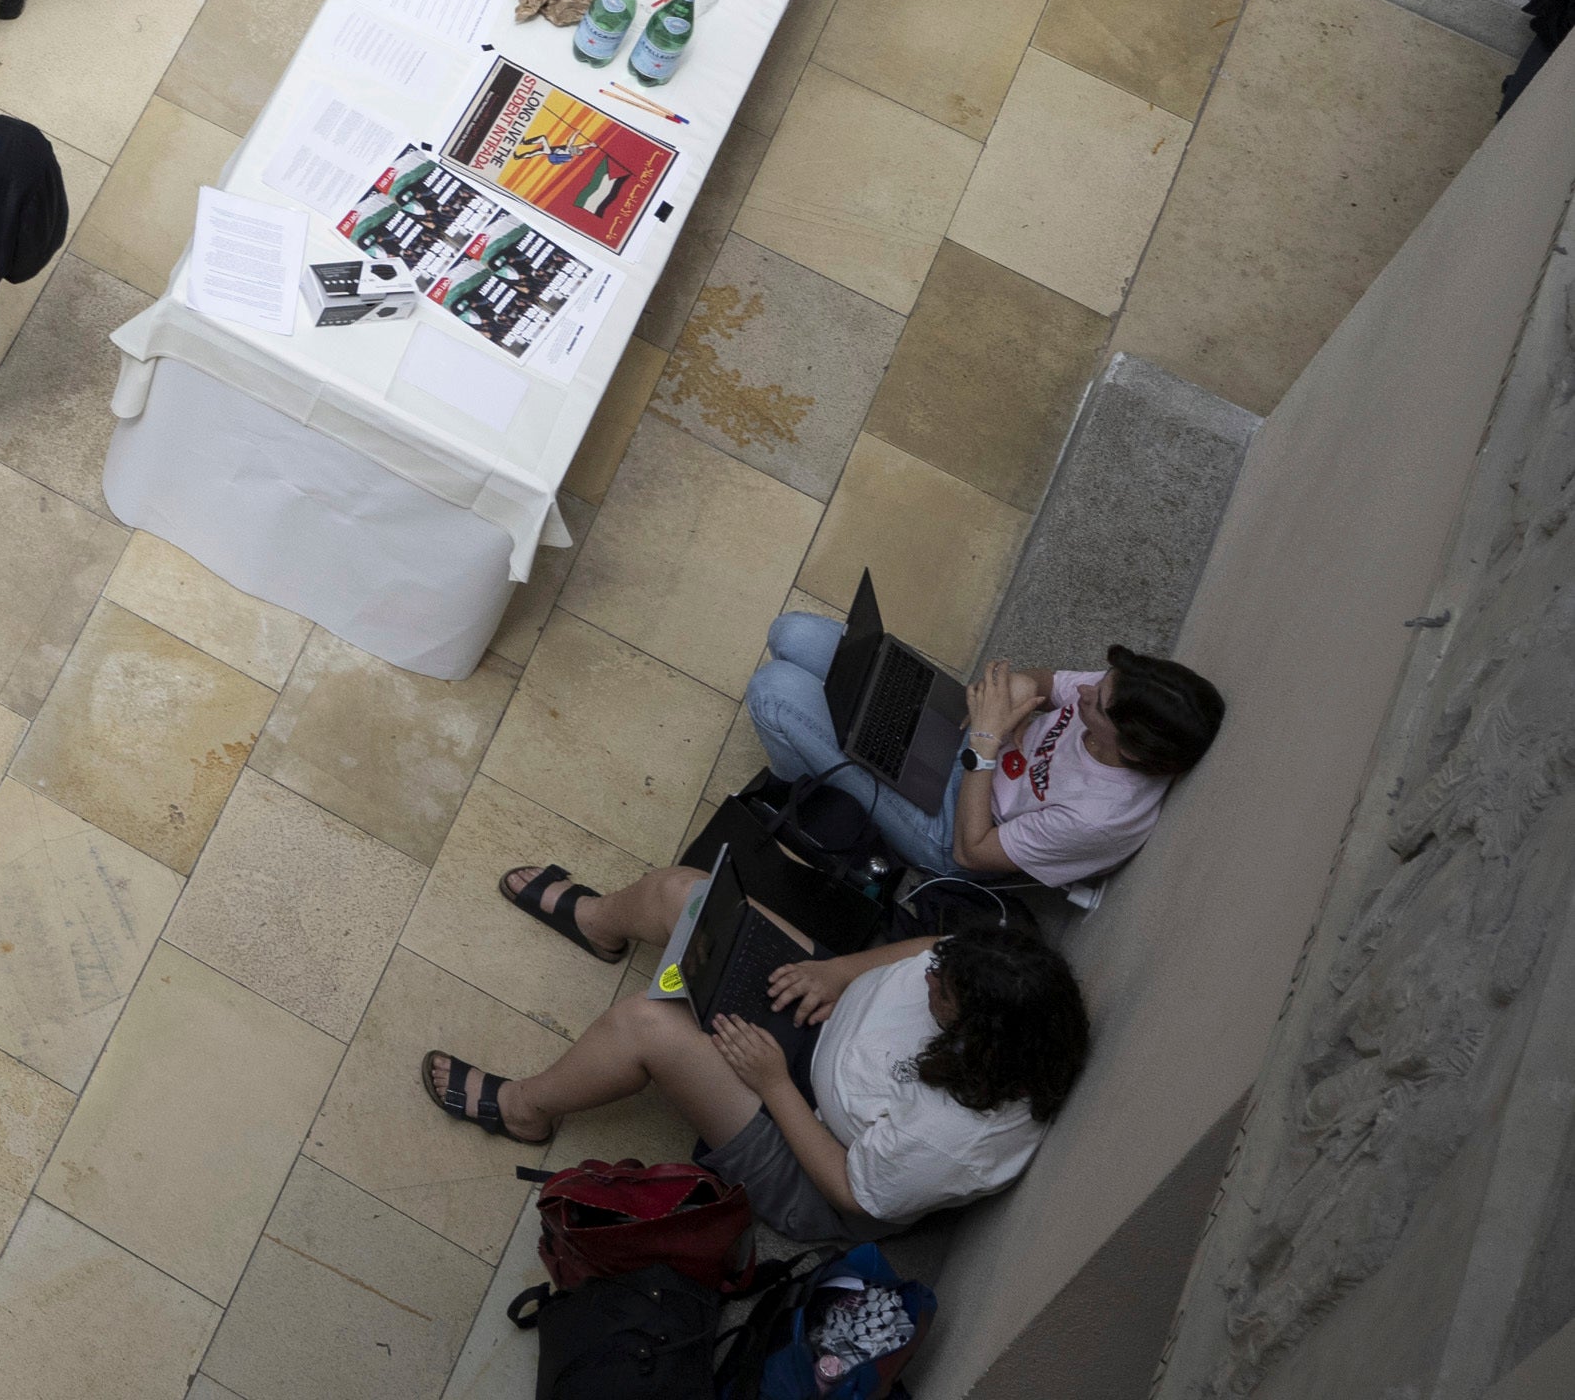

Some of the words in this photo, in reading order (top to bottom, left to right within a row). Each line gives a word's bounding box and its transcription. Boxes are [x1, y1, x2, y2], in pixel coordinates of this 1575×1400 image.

[499, 74, 537, 127] STUDENT
[517, 89, 544, 123] LONG
[471, 123, 507, 173] INTIFADA
[503, 120, 525, 147] LIVE
[490, 144, 512, 169] THE
